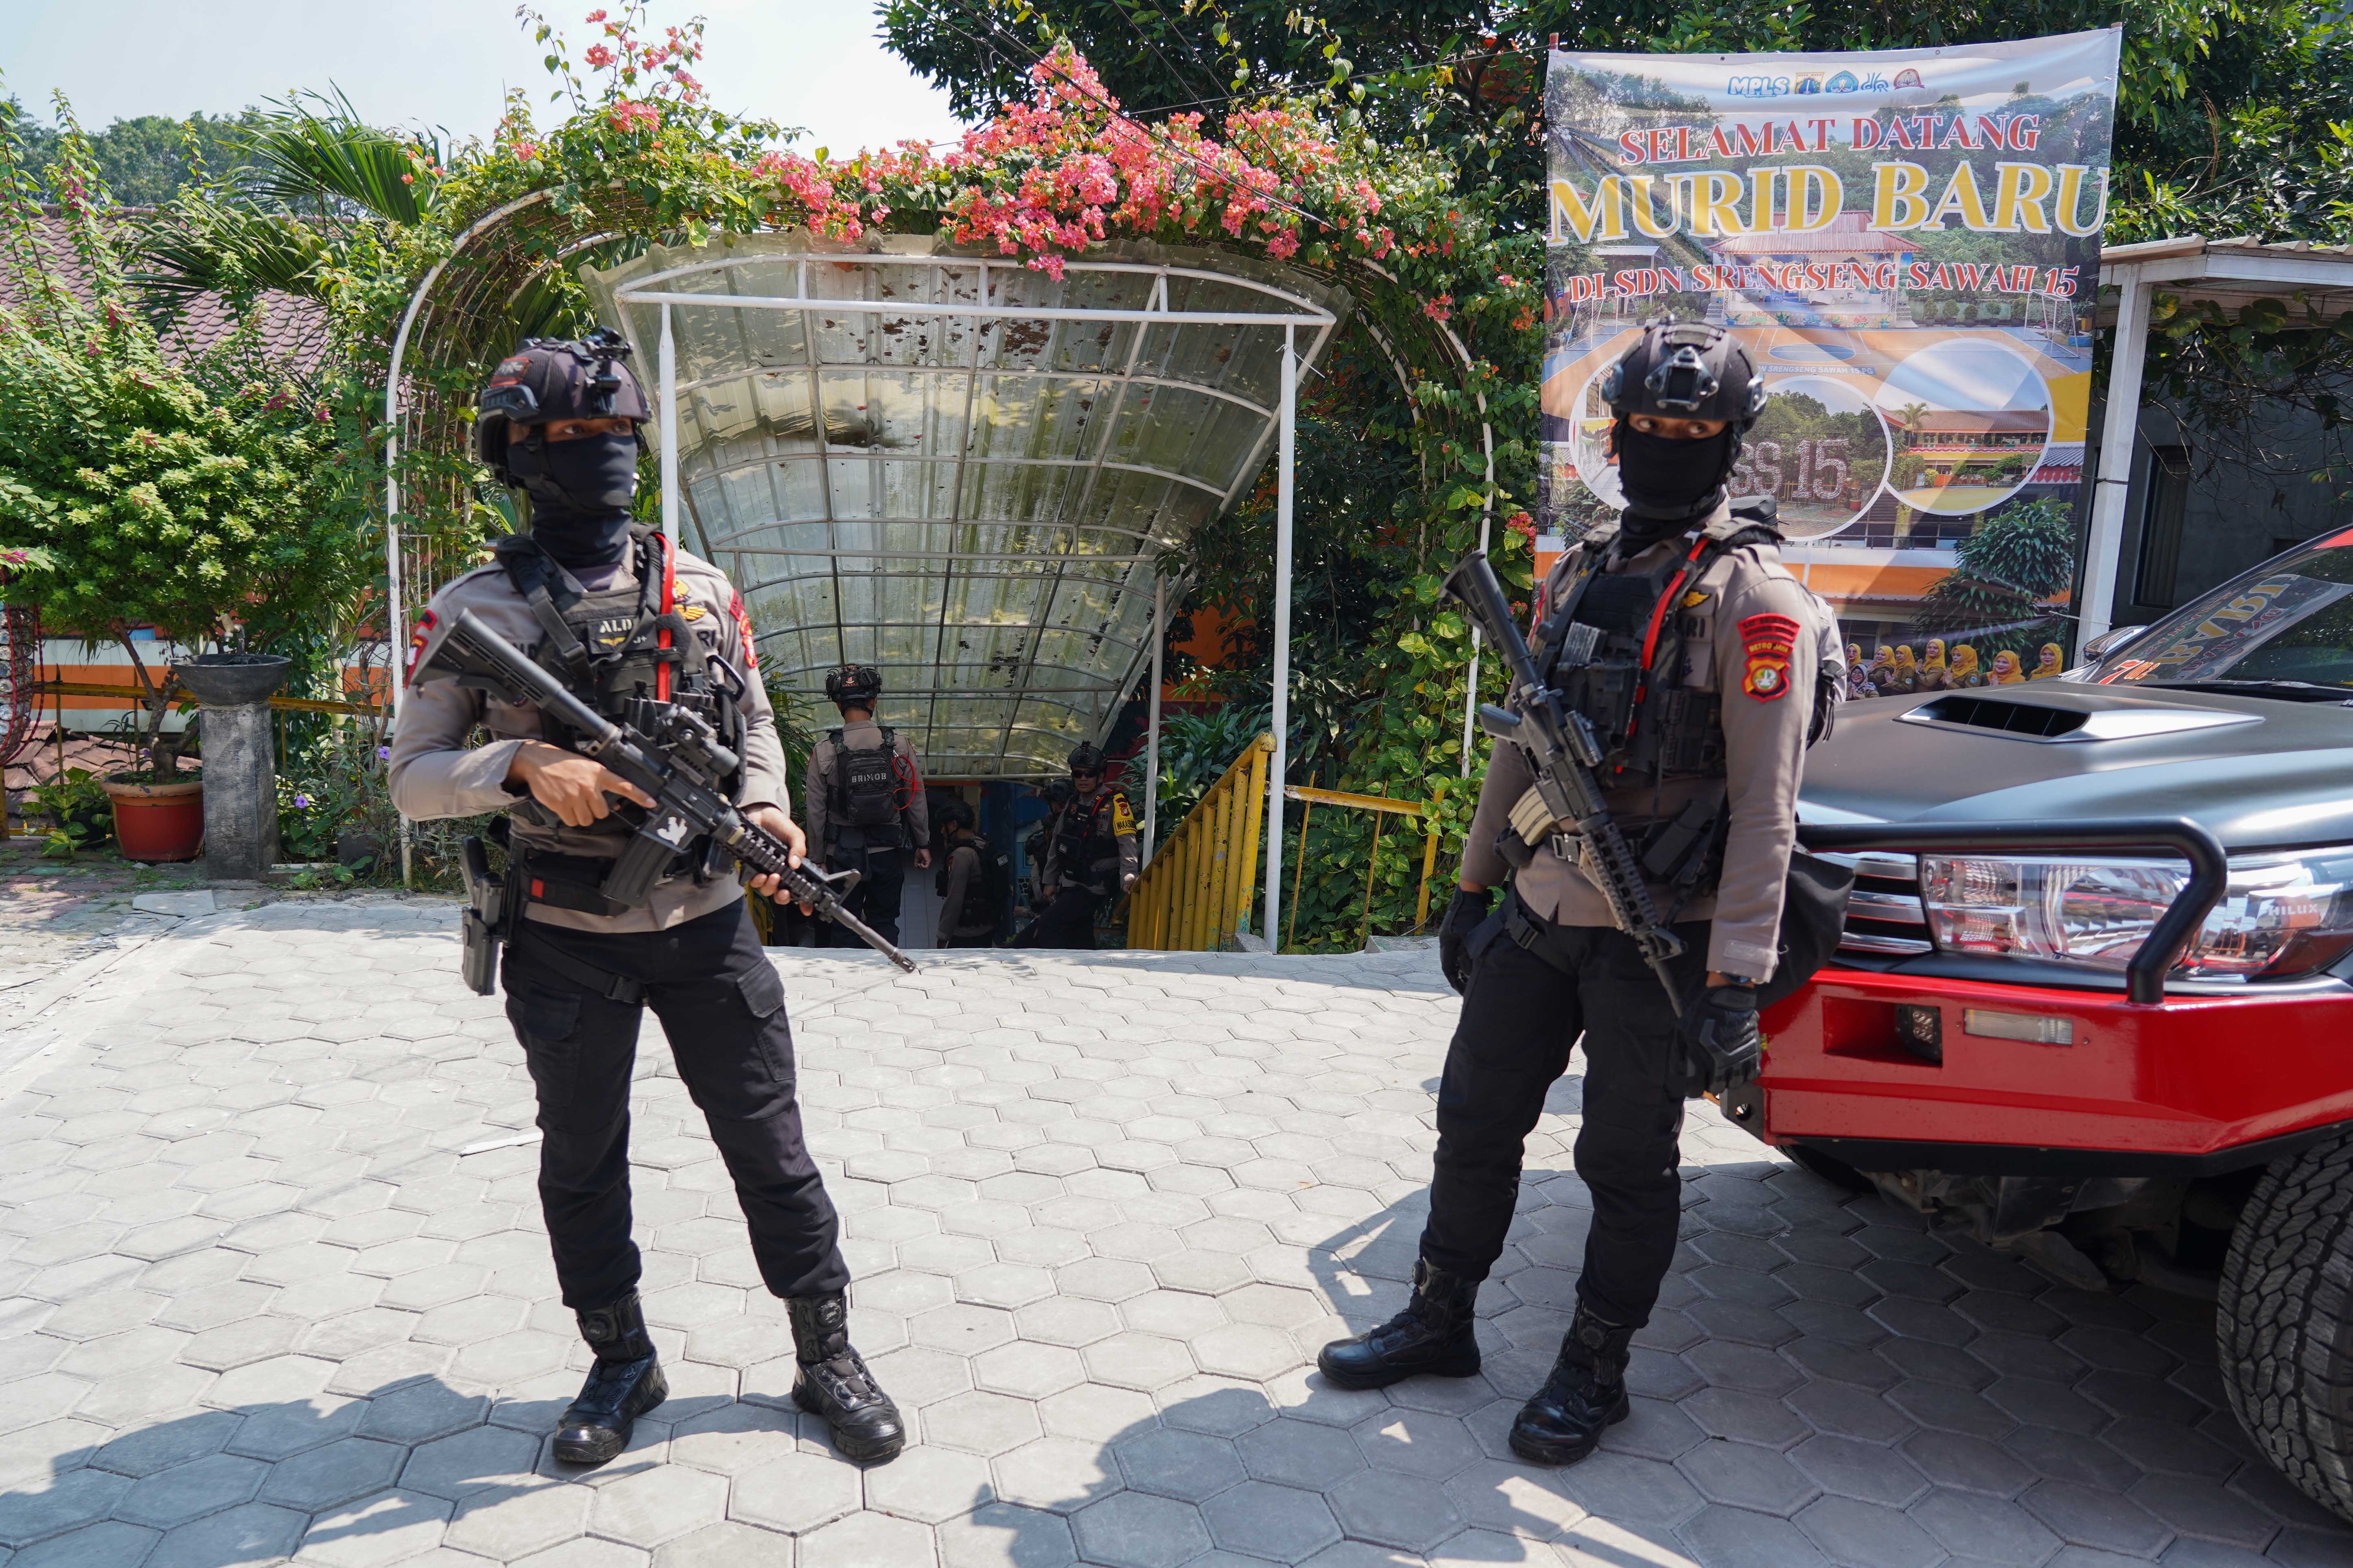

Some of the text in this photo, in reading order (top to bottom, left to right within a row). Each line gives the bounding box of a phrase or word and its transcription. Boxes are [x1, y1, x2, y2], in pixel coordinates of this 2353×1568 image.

[1729, 76, 1789, 95] MPLS
[1619, 114, 2041, 165] SELAMAT DATANG
[1547, 160, 2110, 246] MURID BARU
[1569, 262, 2080, 303] DI SDN SRENGSENG SAWAH 15
[1792, 439, 1849, 500] 15
[599, 618, 632, 634] ALD
[852, 773, 886, 783] BRIMOB
[2268, 900, 2319, 916] HILUX
